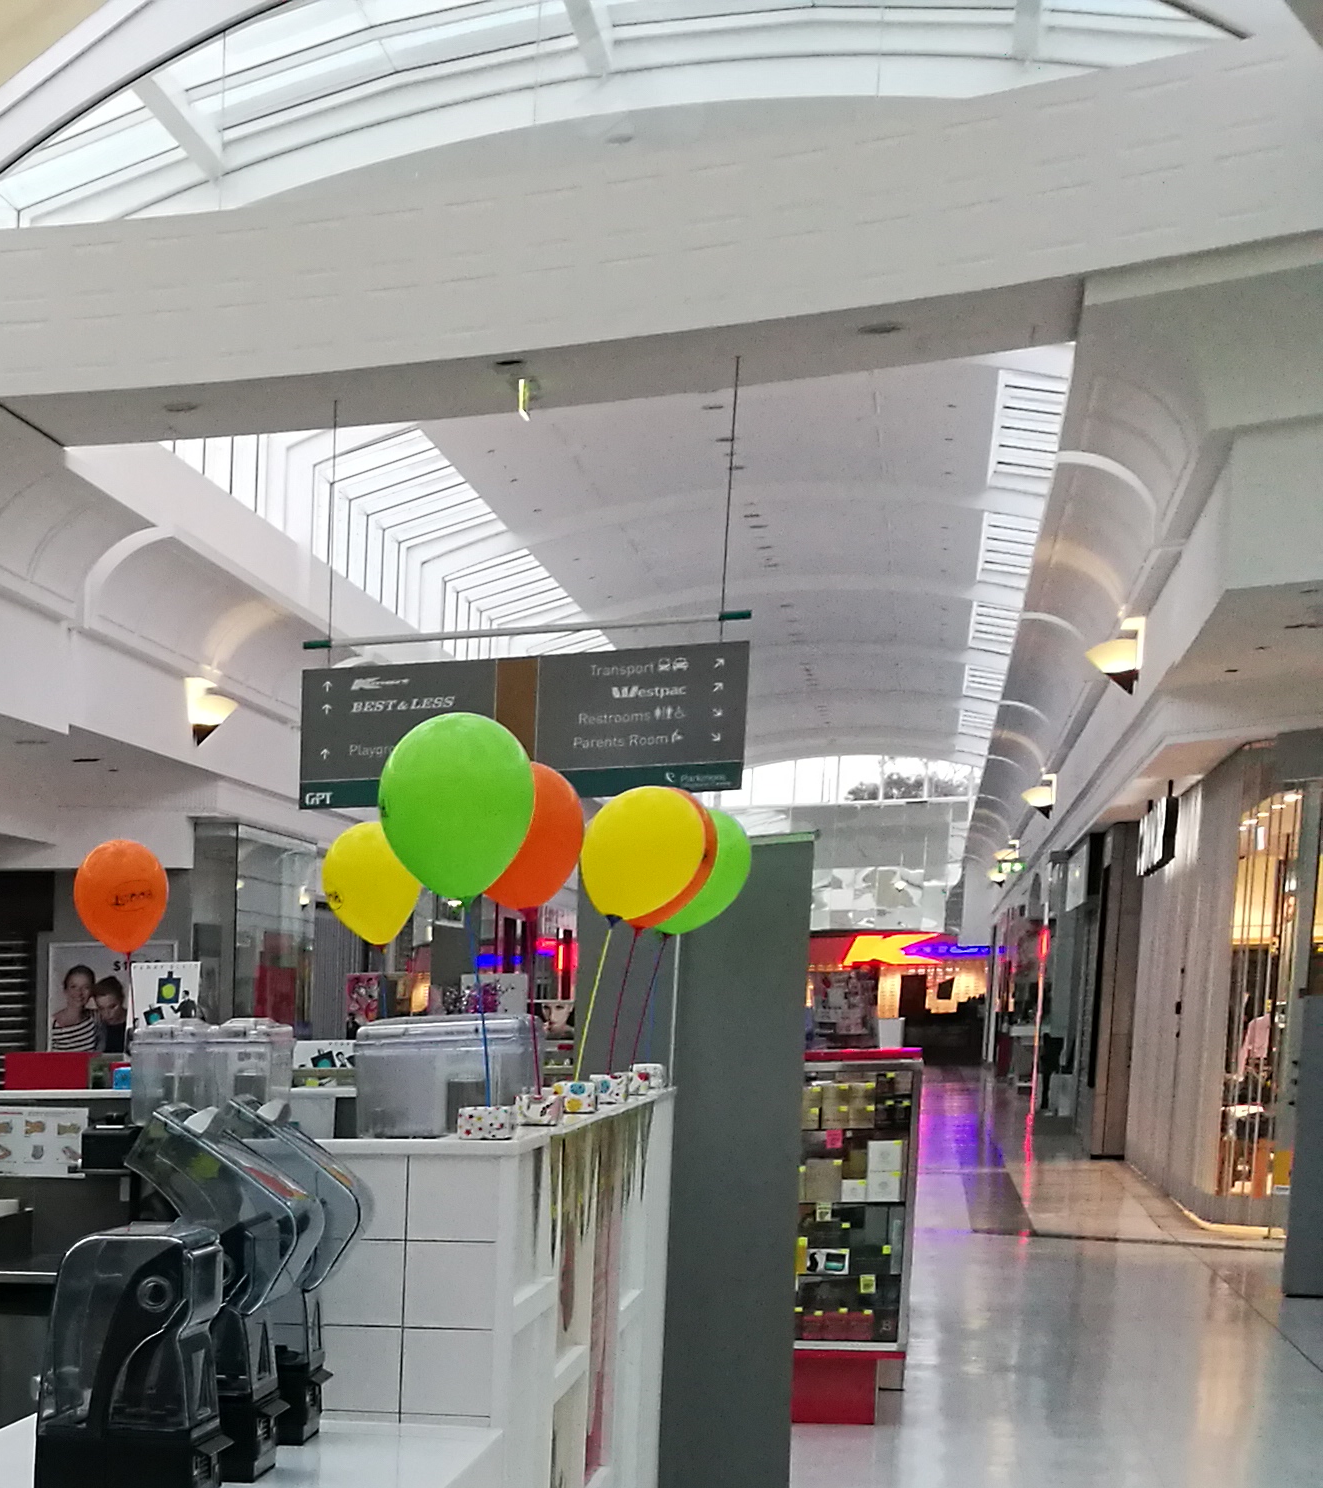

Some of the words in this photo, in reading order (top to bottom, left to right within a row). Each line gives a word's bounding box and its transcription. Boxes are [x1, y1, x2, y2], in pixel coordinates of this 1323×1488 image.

[590, 662, 654, 677] Transport
[611, 685, 687, 699] Westpac
[351, 698, 396, 713] BEST
[397, 701, 408, 711] &
[410, 695, 456, 710] LESS
[578, 710, 651, 725] Restrooms
[573, 736, 625, 750] Parents
[628, 734, 669, 747] Room
[304, 792, 334, 805] GPT
